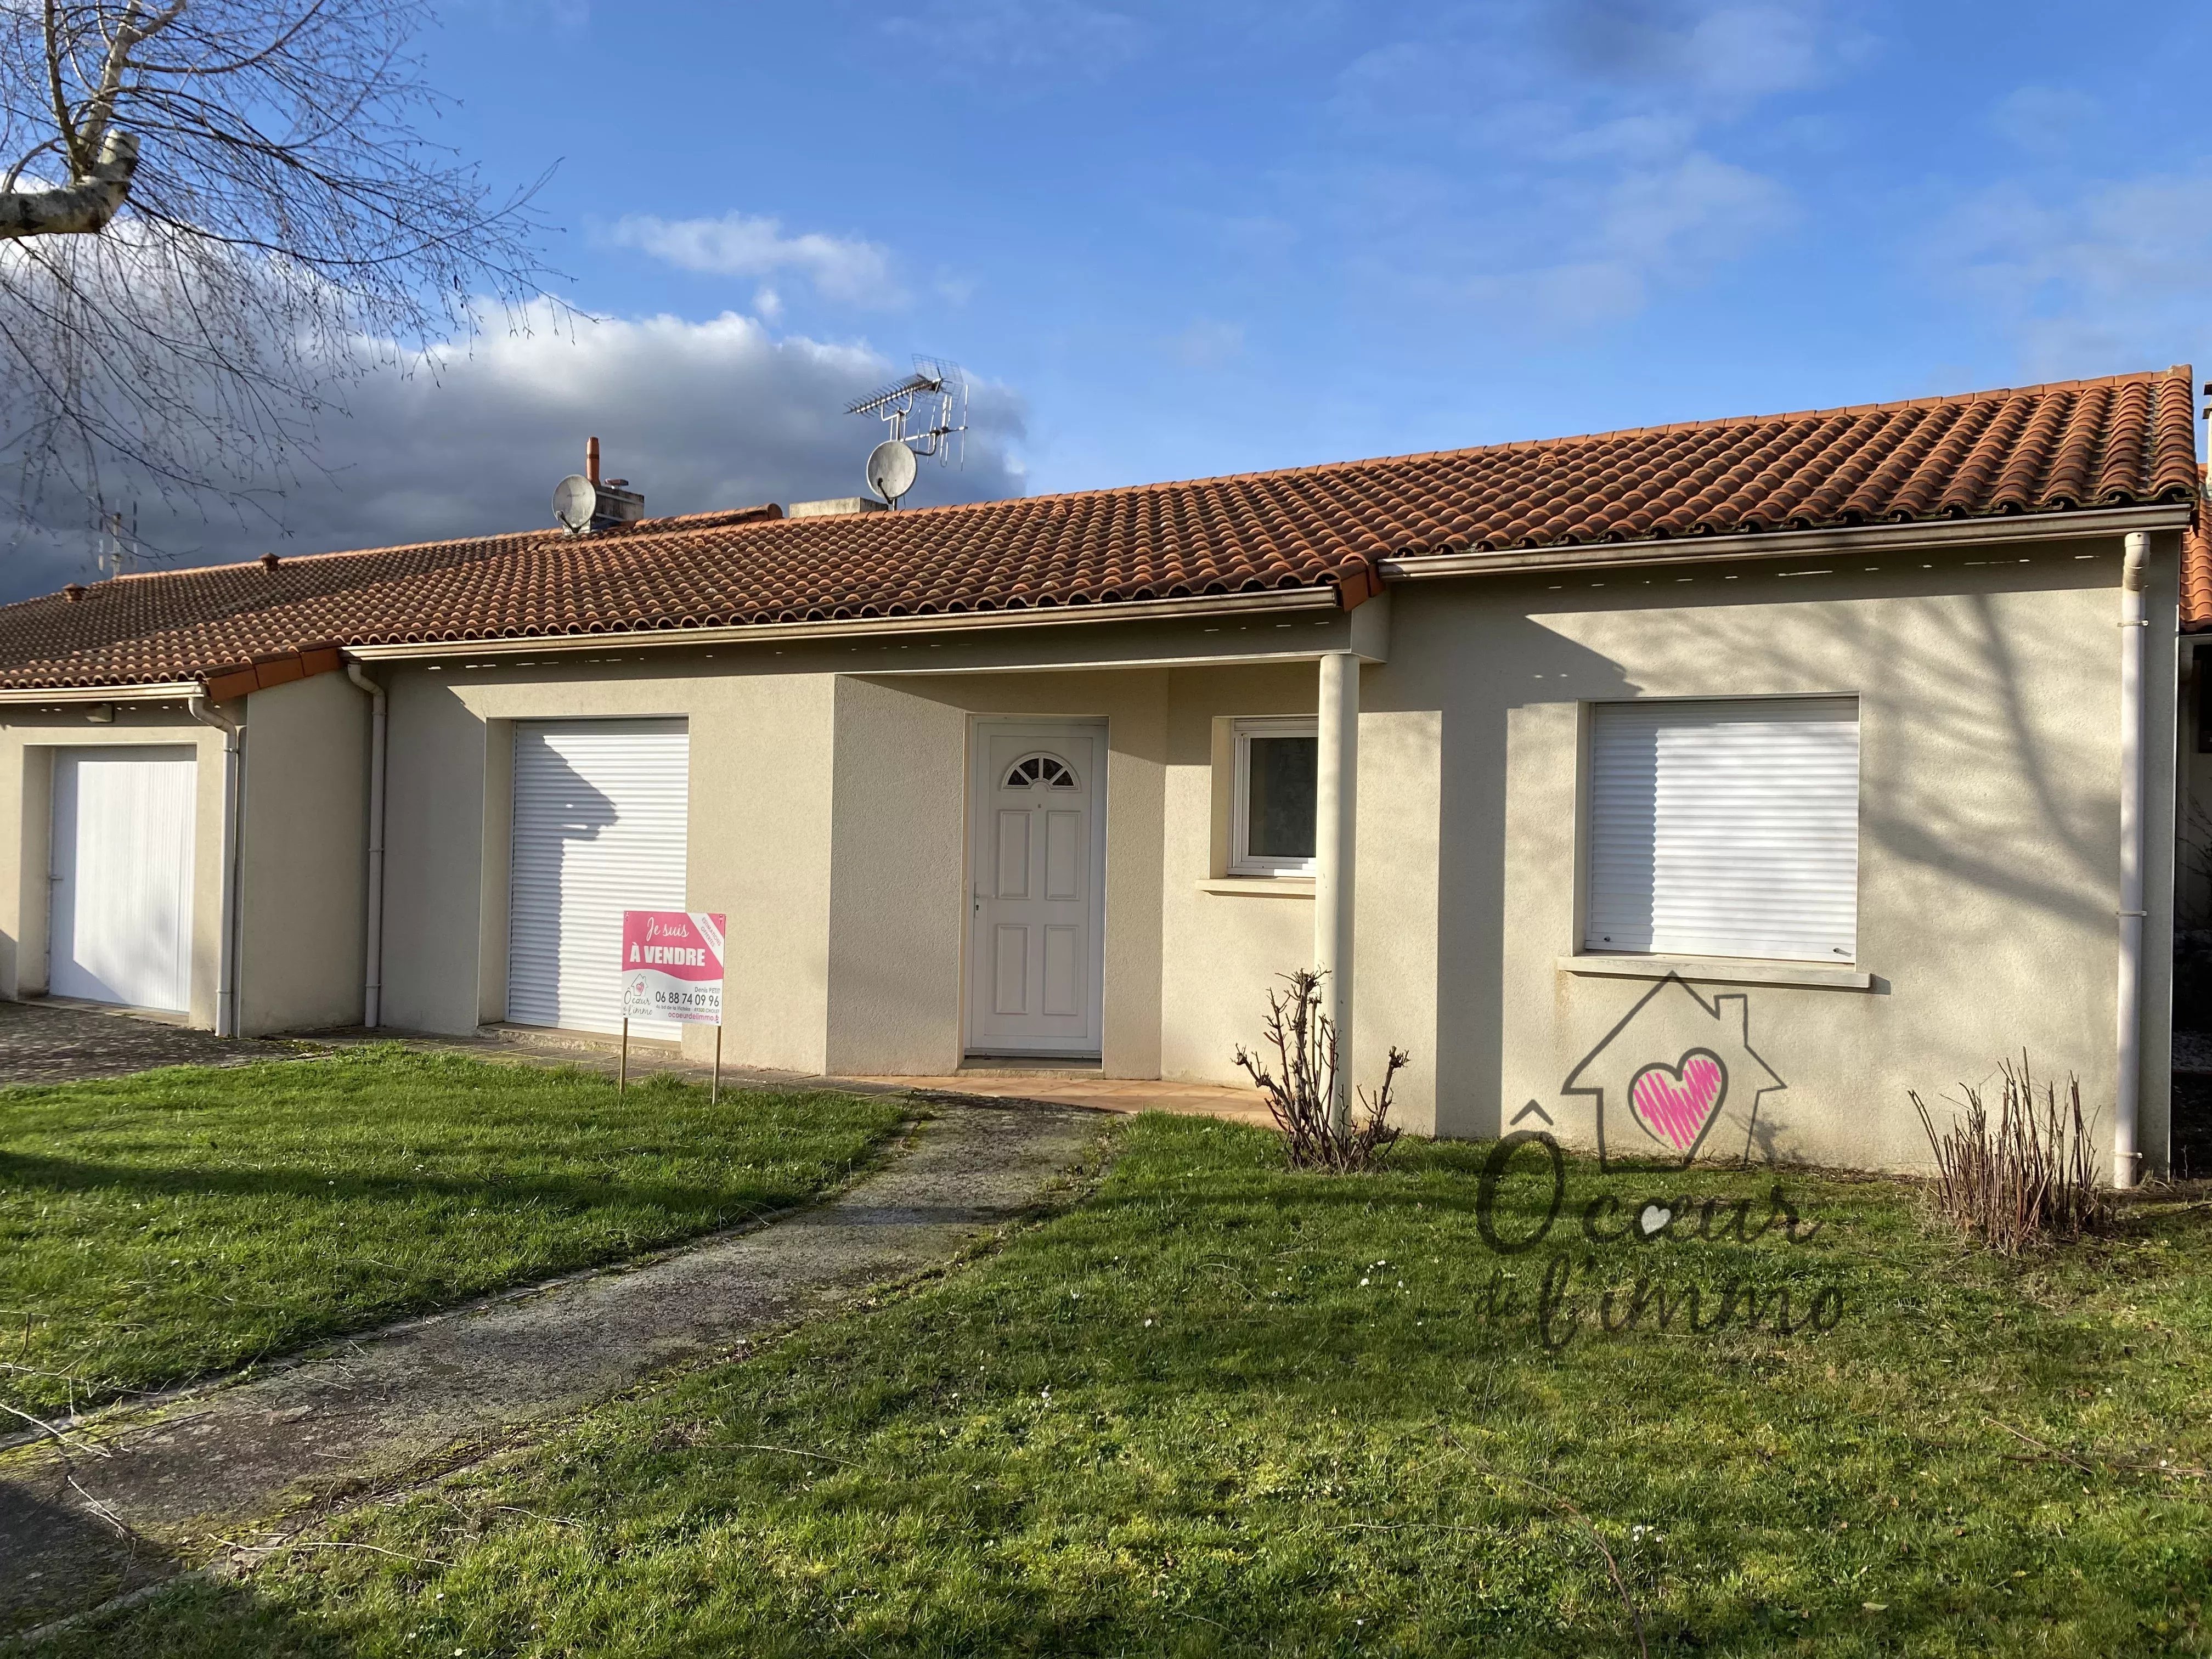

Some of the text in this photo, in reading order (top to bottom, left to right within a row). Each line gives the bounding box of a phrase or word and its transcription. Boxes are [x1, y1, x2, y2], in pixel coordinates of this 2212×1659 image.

[646, 917, 690, 941] Je suis
[701, 926, 715, 947] OFFERTES
[702, 917, 721, 946] ESTIMATIONS
[630, 941, 706, 967] À VENDRE
[656, 991, 719, 1007] 06 88 74 09 96
